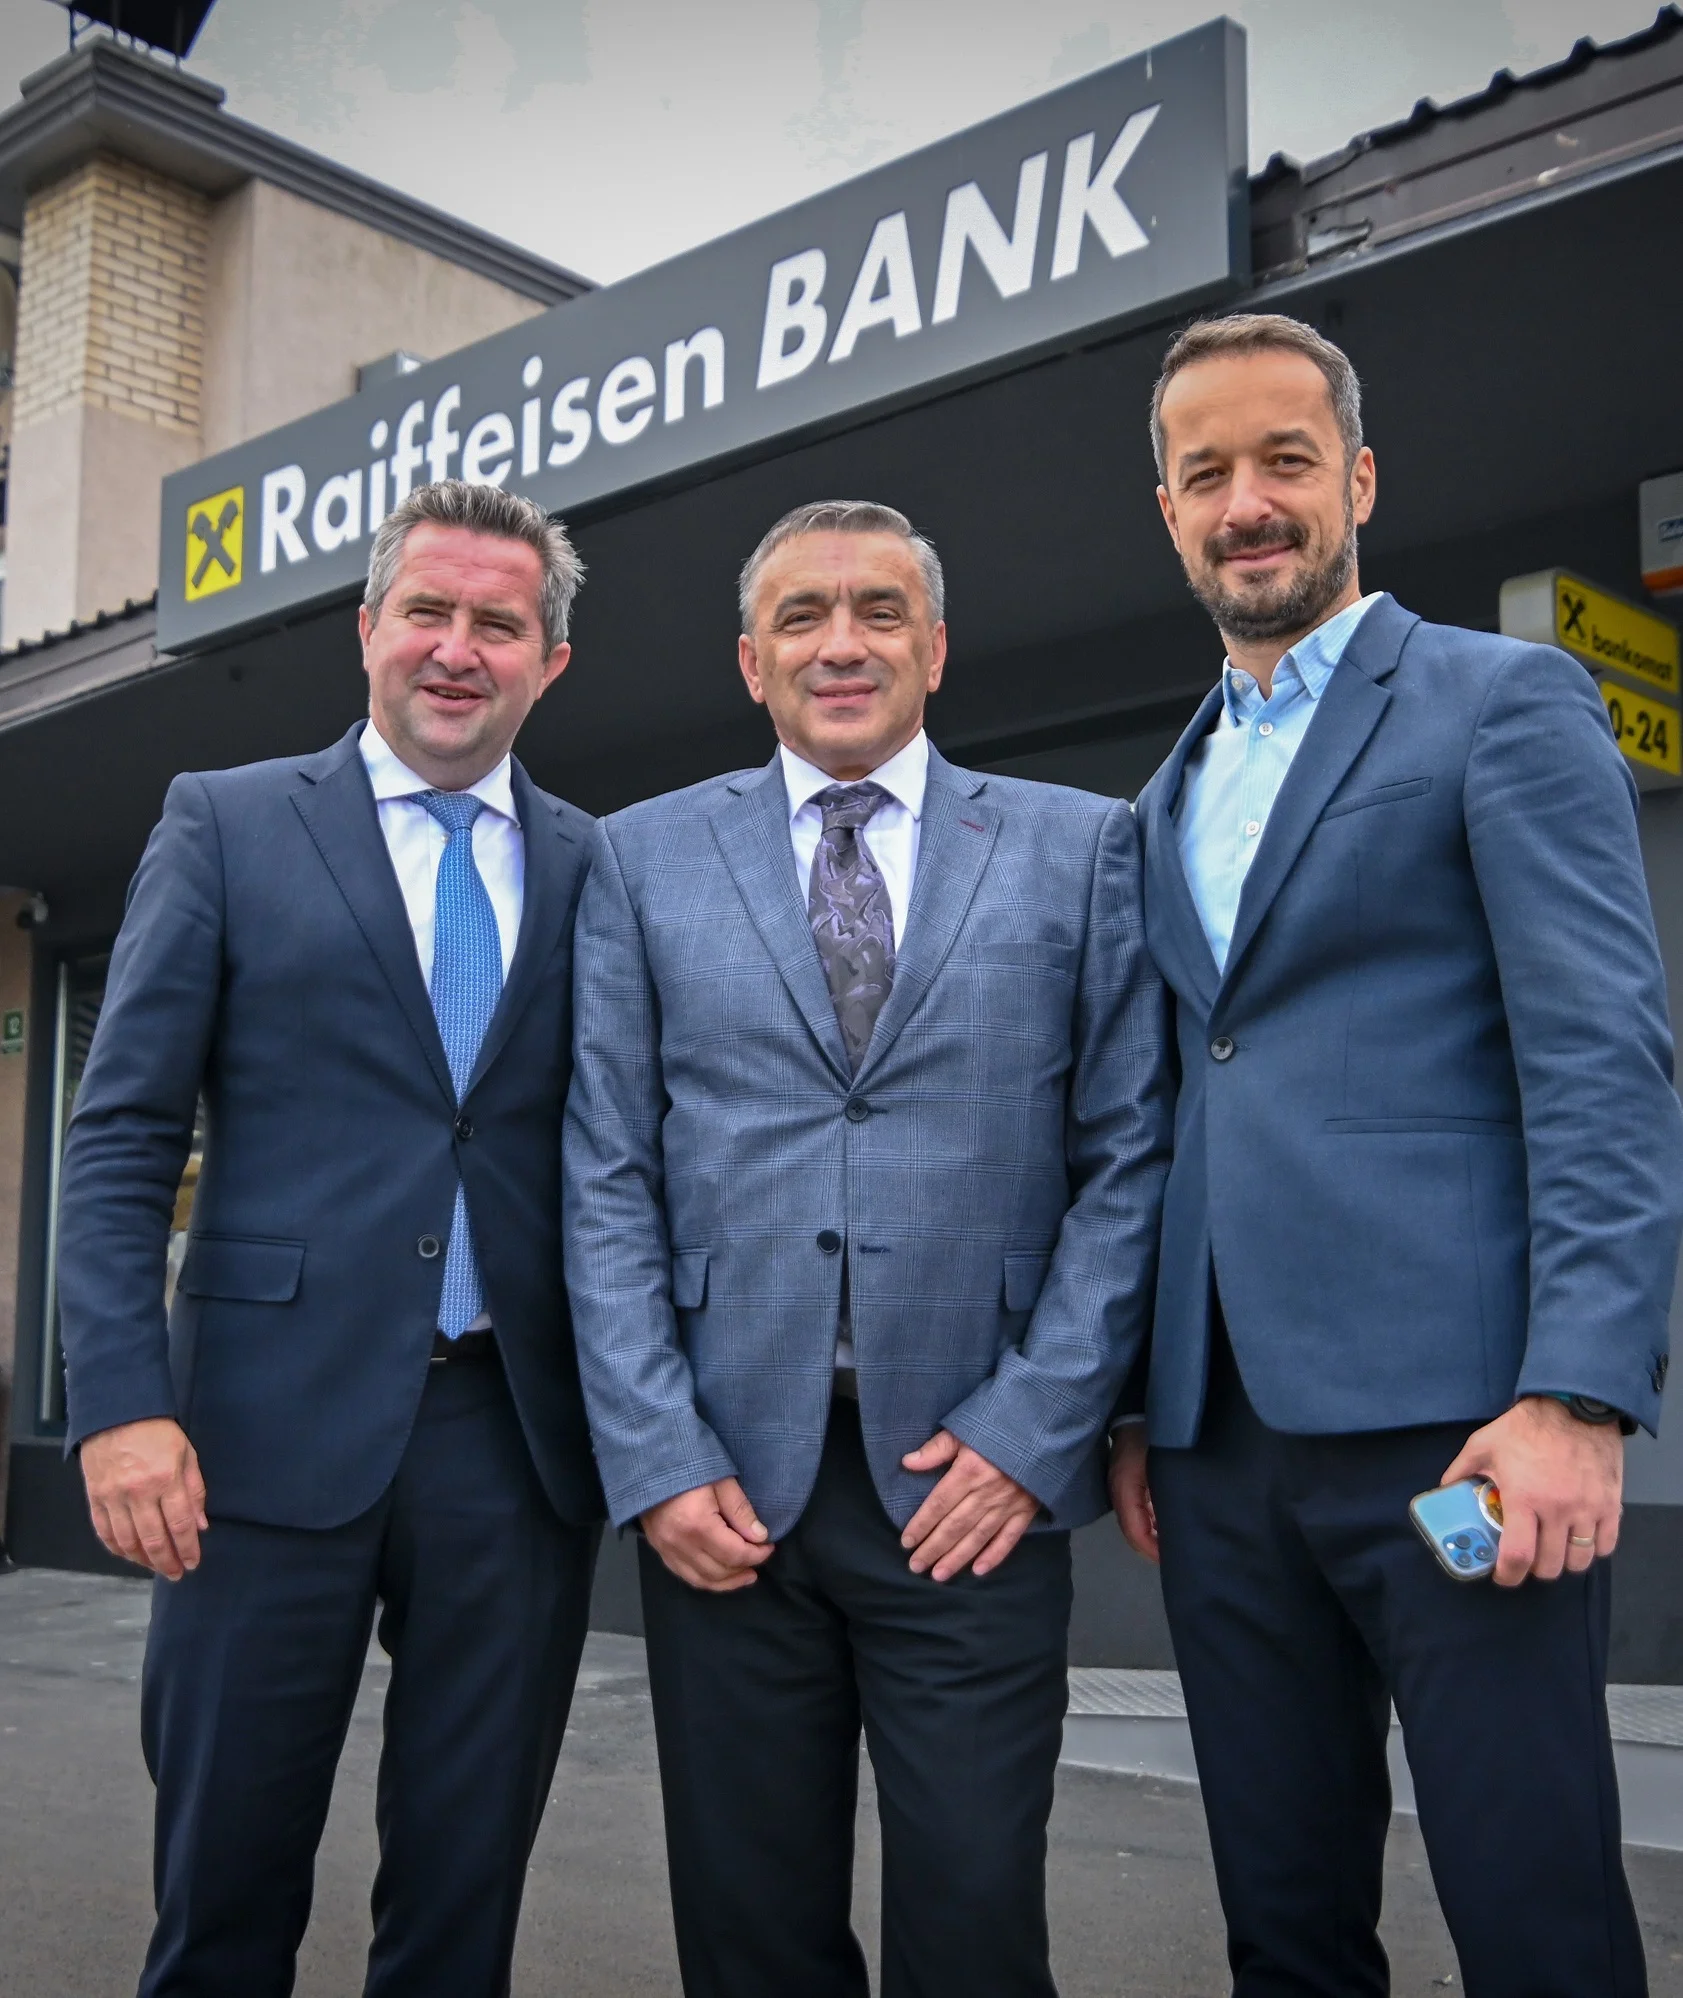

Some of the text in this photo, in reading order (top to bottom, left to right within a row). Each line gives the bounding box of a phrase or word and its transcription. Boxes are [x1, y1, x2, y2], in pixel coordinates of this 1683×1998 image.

[259, 101, 1163, 574] Raiffeisen BANK
[1592, 624, 1674, 681] bankomat
[1607, 697, 1669, 759] 0-24
